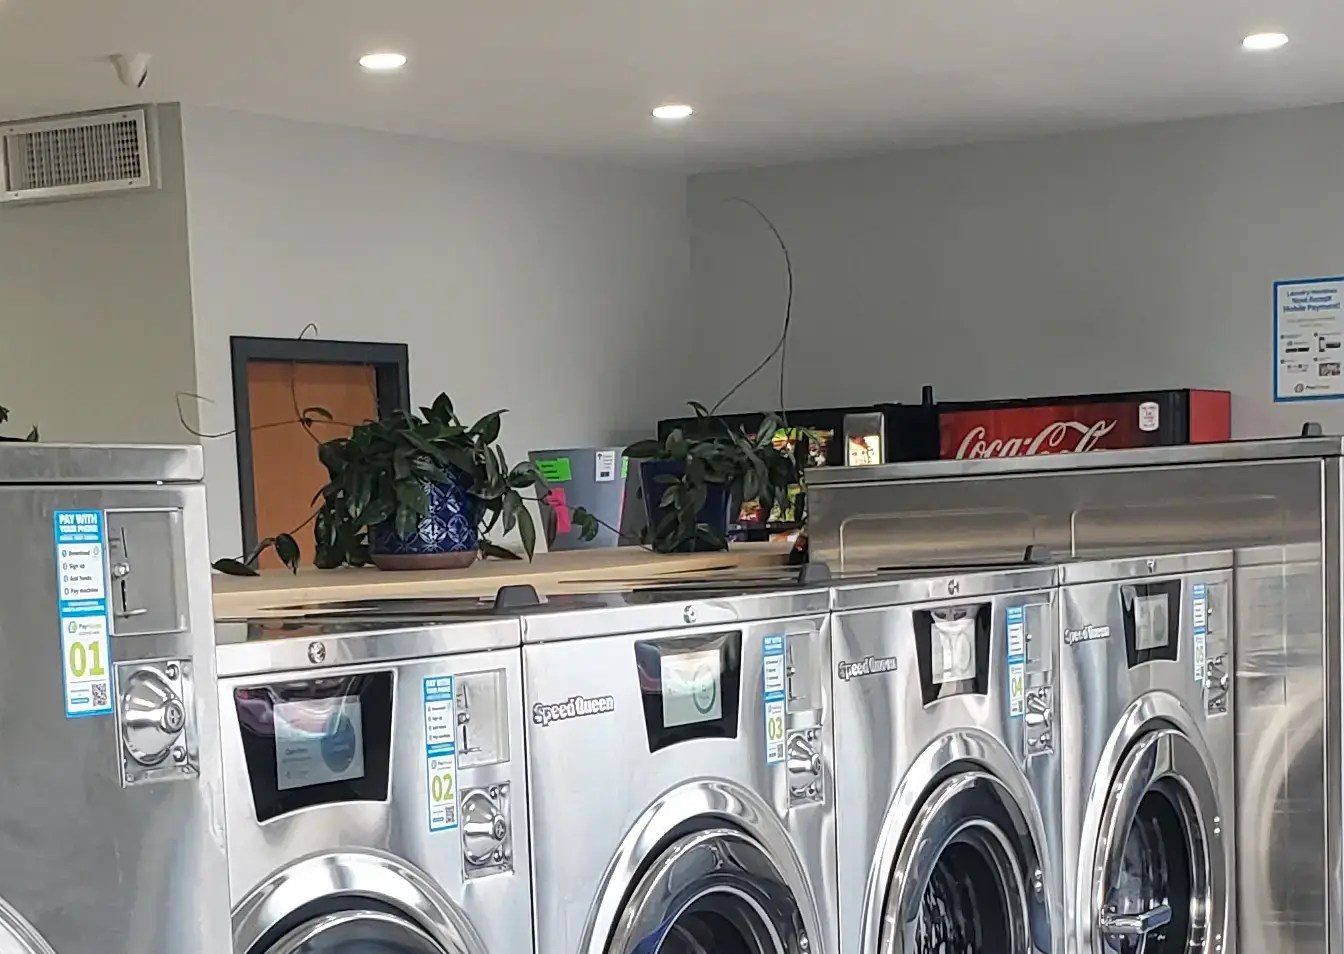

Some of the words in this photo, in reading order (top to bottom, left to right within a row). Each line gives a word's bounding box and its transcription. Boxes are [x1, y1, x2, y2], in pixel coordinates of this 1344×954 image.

[59, 513, 75, 525] PAY
[76, 512, 98, 525] WITH
[69, 640, 105, 677] 01
[1011, 676, 1023, 698] 04
[533, 697, 576, 727] Speed
[574, 695, 615, 717] Queen
[768, 716, 783, 741] 03
[431, 773, 454, 802] 02
